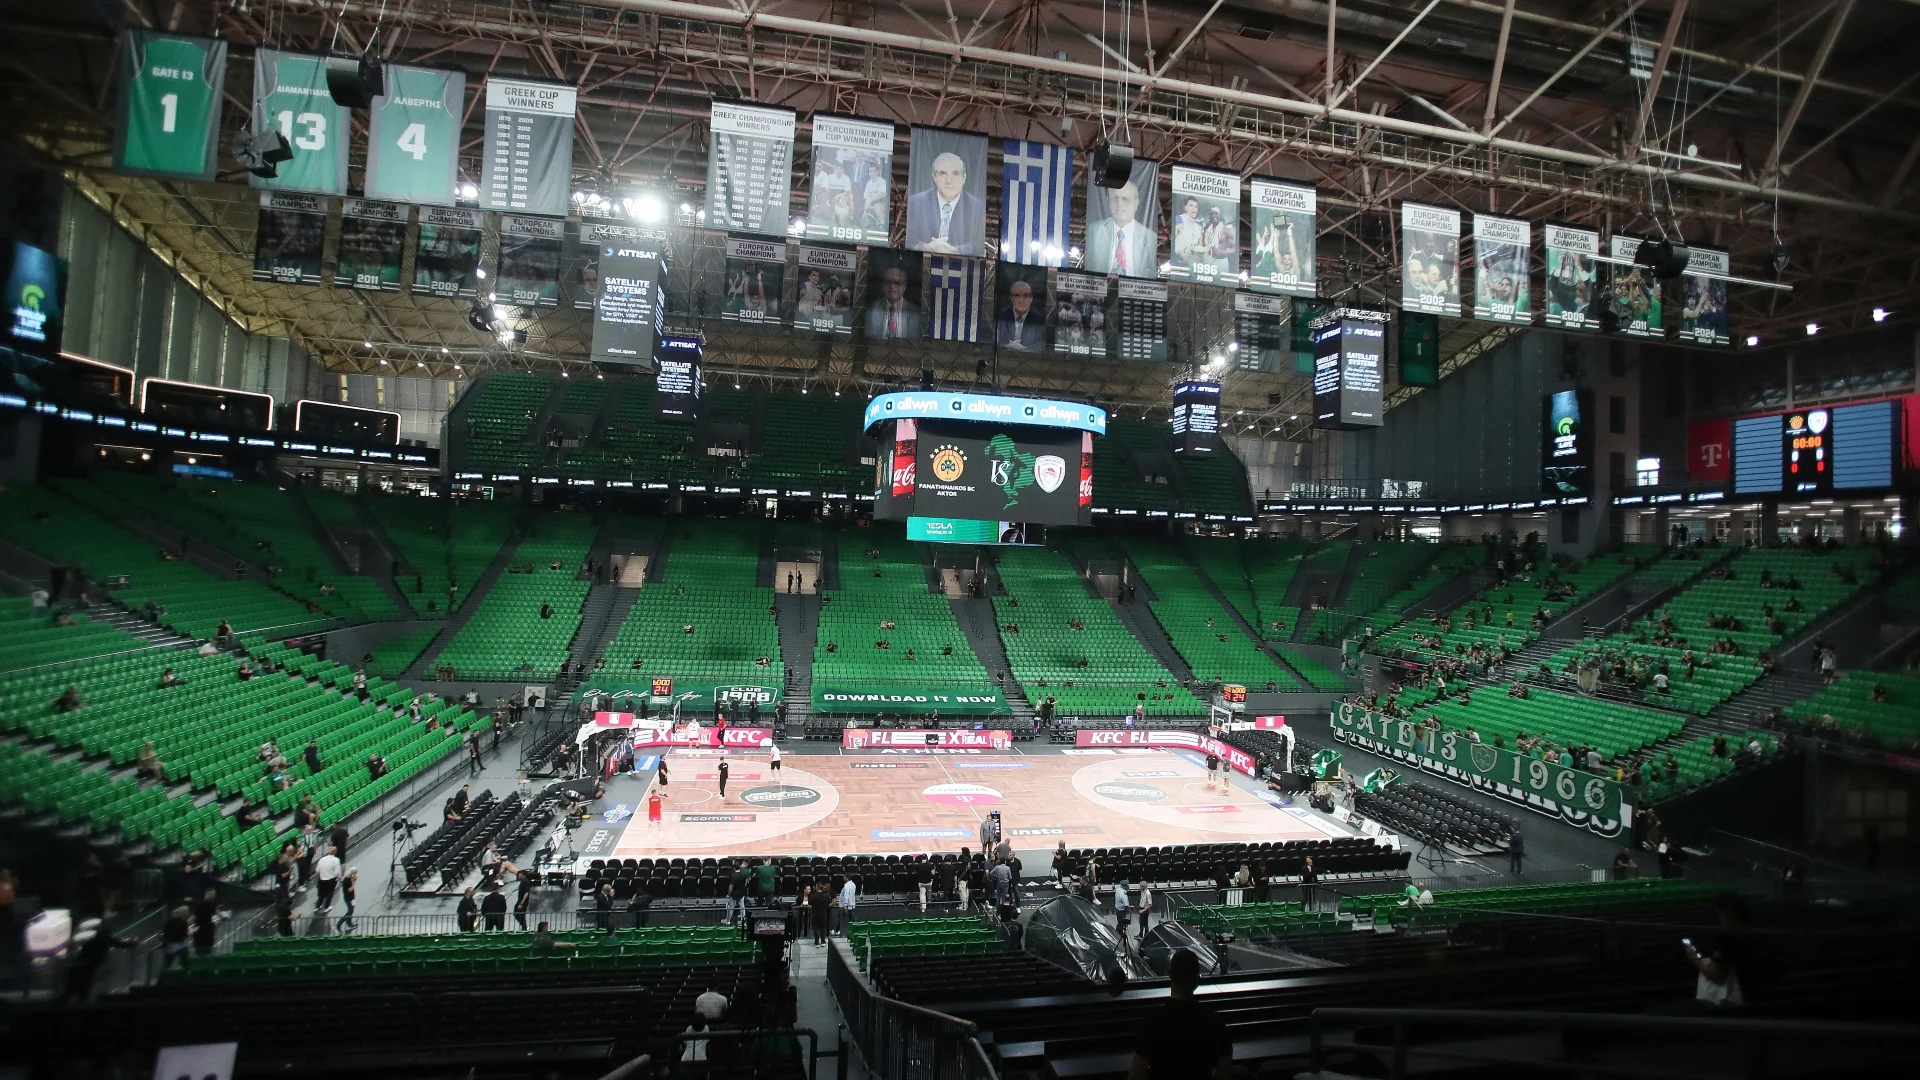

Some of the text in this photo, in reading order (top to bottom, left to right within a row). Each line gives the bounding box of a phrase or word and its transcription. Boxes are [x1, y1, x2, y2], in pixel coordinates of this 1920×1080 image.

[152, 67, 194, 80] GATE 13
[505, 87, 558, 100] GREEK CUP
[394, 96, 441, 109] ΑΛΒΕΡΤΗΣ
[508, 97, 554, 109] WINNERS
[161, 93, 178, 133] 1
[713, 111, 794, 127] GREEK CHAMPIONSHIP
[278, 111, 326, 150] 13
[736, 121, 770, 131] WINNERS
[816, 124, 890, 139] INTERCONTINENTAL
[397, 123, 426, 160] 4
[826, 133, 879, 146] CUP WINNERS
[1185, 174, 1228, 187] EUROPEAN
[1182, 182, 1230, 196] CHAMPIONS
[1265, 188, 1303, 200] EUROPEAN
[270, 199, 318, 210] CHAMPIONS
[356, 201, 396, 211] EUROPEAN
[1262, 196, 1306, 208] CHAMPIONS
[352, 207, 399, 218] CHAMPIONS
[432, 209, 472, 218] EUROPEAN
[1414, 210, 1450, 222] EUROPEAN
[428, 216, 474, 225] CHAMPIONS
[514, 219, 553, 228] EUROPEAN
[1411, 218, 1452, 230] CHAMPIONS
[510, 225, 555, 235] CHAMPIONS
[832, 226, 862, 240] 1996
[1485, 222, 1520, 233] EUROPEAN
[1482, 229, 1522, 241] CHAMPIONS
[1556, 231, 1589, 242] EUROPEAN
[739, 243, 775, 252] EUROPEAN
[1553, 239, 1591, 250] CHAMPIONS
[618, 249, 657, 259] ATTISAT
[736, 249, 776, 258] CHAMPIONS
[810, 250, 847, 260] EUROPEAN
[1689, 253, 1720, 262] EUROPEAN
[807, 256, 848, 267] CHAMPIONS
[273, 267, 301, 277] 2024
[1193, 263, 1218, 275] 1996
[357, 274, 378, 284] 2011
[605, 277, 650, 288] SATELLITE
[1271, 272, 1297, 284] 2000
[431, 281, 459, 291] 2009
[607, 285, 647, 295] SYSTEMS
[513, 290, 540, 300] 2007
[1419, 294, 1444, 306] 2002
[1491, 303, 1515, 314] 2007
[739, 310, 764, 319] 2000
[1561, 311, 1584, 322] 2009
[812, 319, 834, 328] 1996
[1630, 320, 1647, 330] 2011
[1354, 328, 1382, 337] ATTISAT
[1694, 328, 1715, 338] 2024
[669, 341, 696, 349] ATTISAT
[1070, 346, 1089, 354] 1996
[1346, 352, 1379, 360] SATELLITE
[1348, 359, 1377, 367] SYSTEMS
[897, 397, 938, 413] allwyn
[968, 400, 1011, 417] allwyn
[1040, 406, 1079, 423] allwyn
[1793, 436, 1821, 448] 60:00
[1792, 448, 1824, 462] 0 0
[991, 459, 1012, 486] VS
[1791, 461, 1824, 474] 0 0
[919, 483, 966, 491] PANATHINAIKOS
[654, 686, 668, 694] 24
[722, 691, 770, 701] 1908
[823, 693, 997, 704] DOWNLOAD IT NOW
[1233, 694, 1245, 702] 24
[723, 729, 762, 743] KFC
[961, 735, 987, 745] REAL
[1090, 731, 1126, 744] KFC
[1229, 750, 1251, 770] KFC
[1338, 703, 1413, 748] GATE
[1427, 728, 1458, 762] 13
[1511, 755, 1606, 810] 1966
